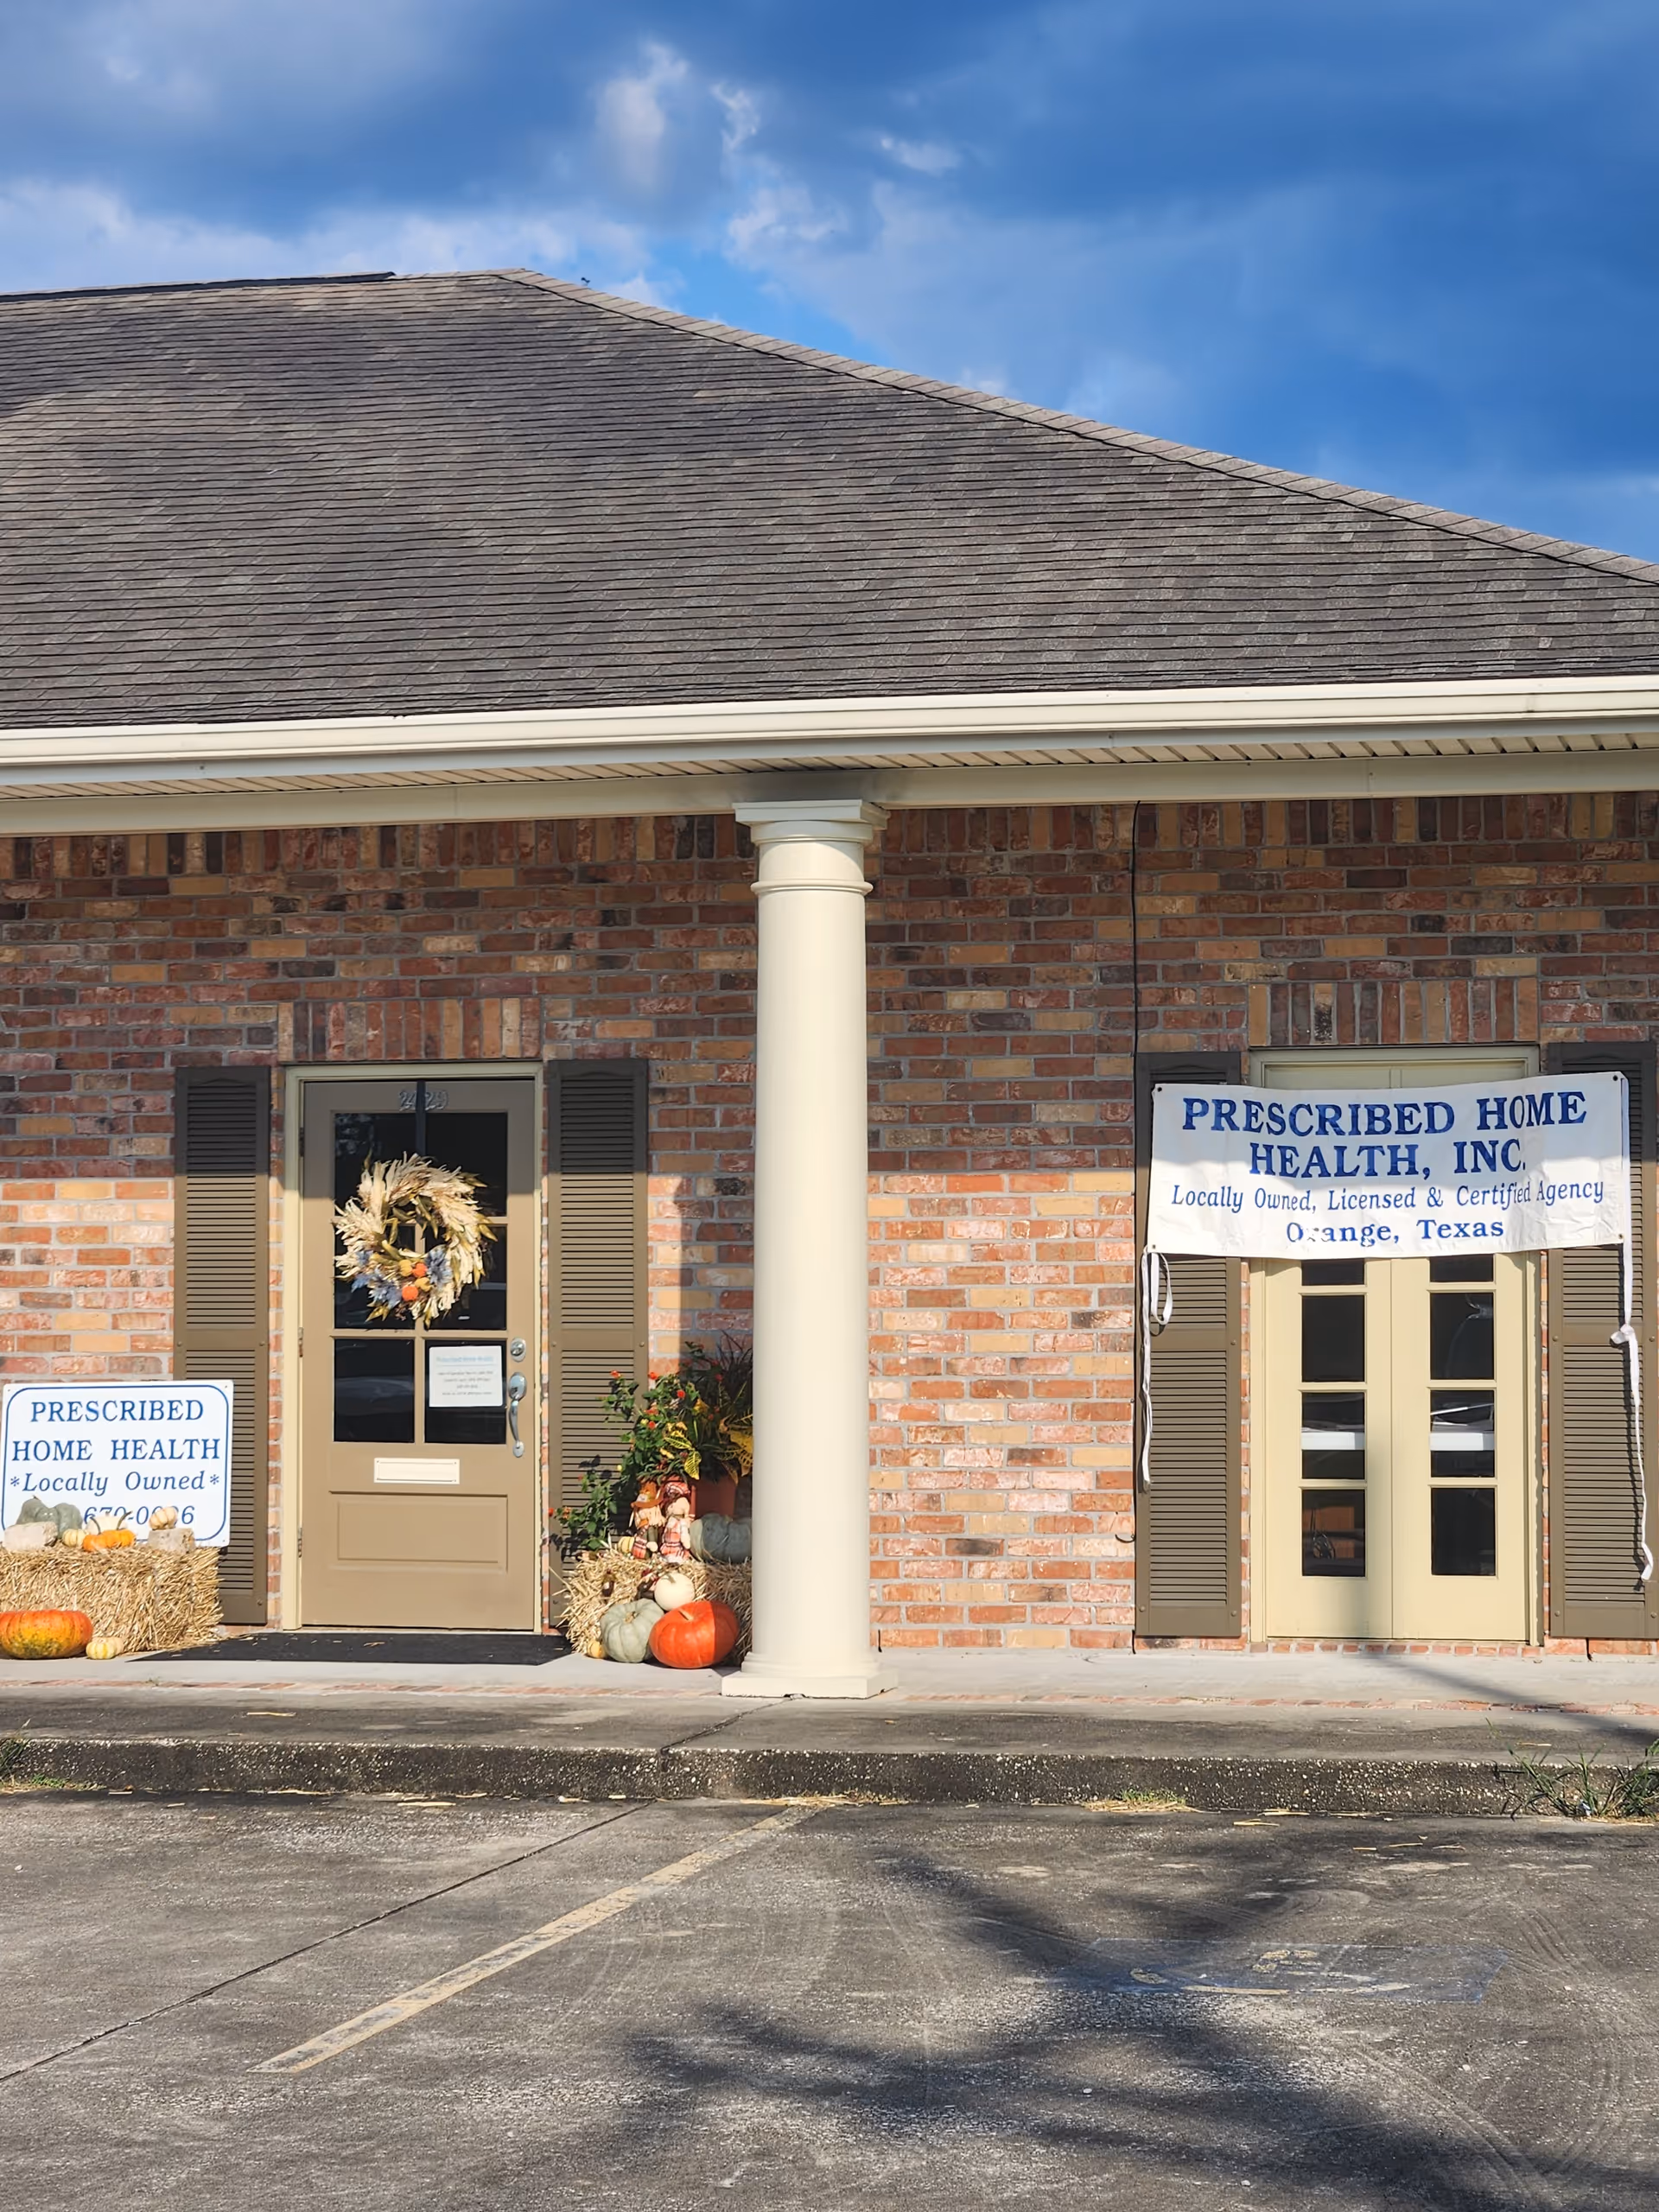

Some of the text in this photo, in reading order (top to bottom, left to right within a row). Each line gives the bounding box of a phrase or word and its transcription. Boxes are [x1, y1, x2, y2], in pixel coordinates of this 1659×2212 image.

[1182, 1090, 1587, 1136] PRESCRIBED HOME
[1249, 1138, 1526, 1180] HEALTH, INC.
[1171, 1179, 1604, 1214] Locally Owned, Licensed & Certified Agency
[1416, 1218, 1503, 1240] Texas
[29, 1399, 205, 1422] PRESCRIBED
[11, 1438, 221, 1462] HOME HEALTH
[83, 1505, 195, 1525] 67-06
